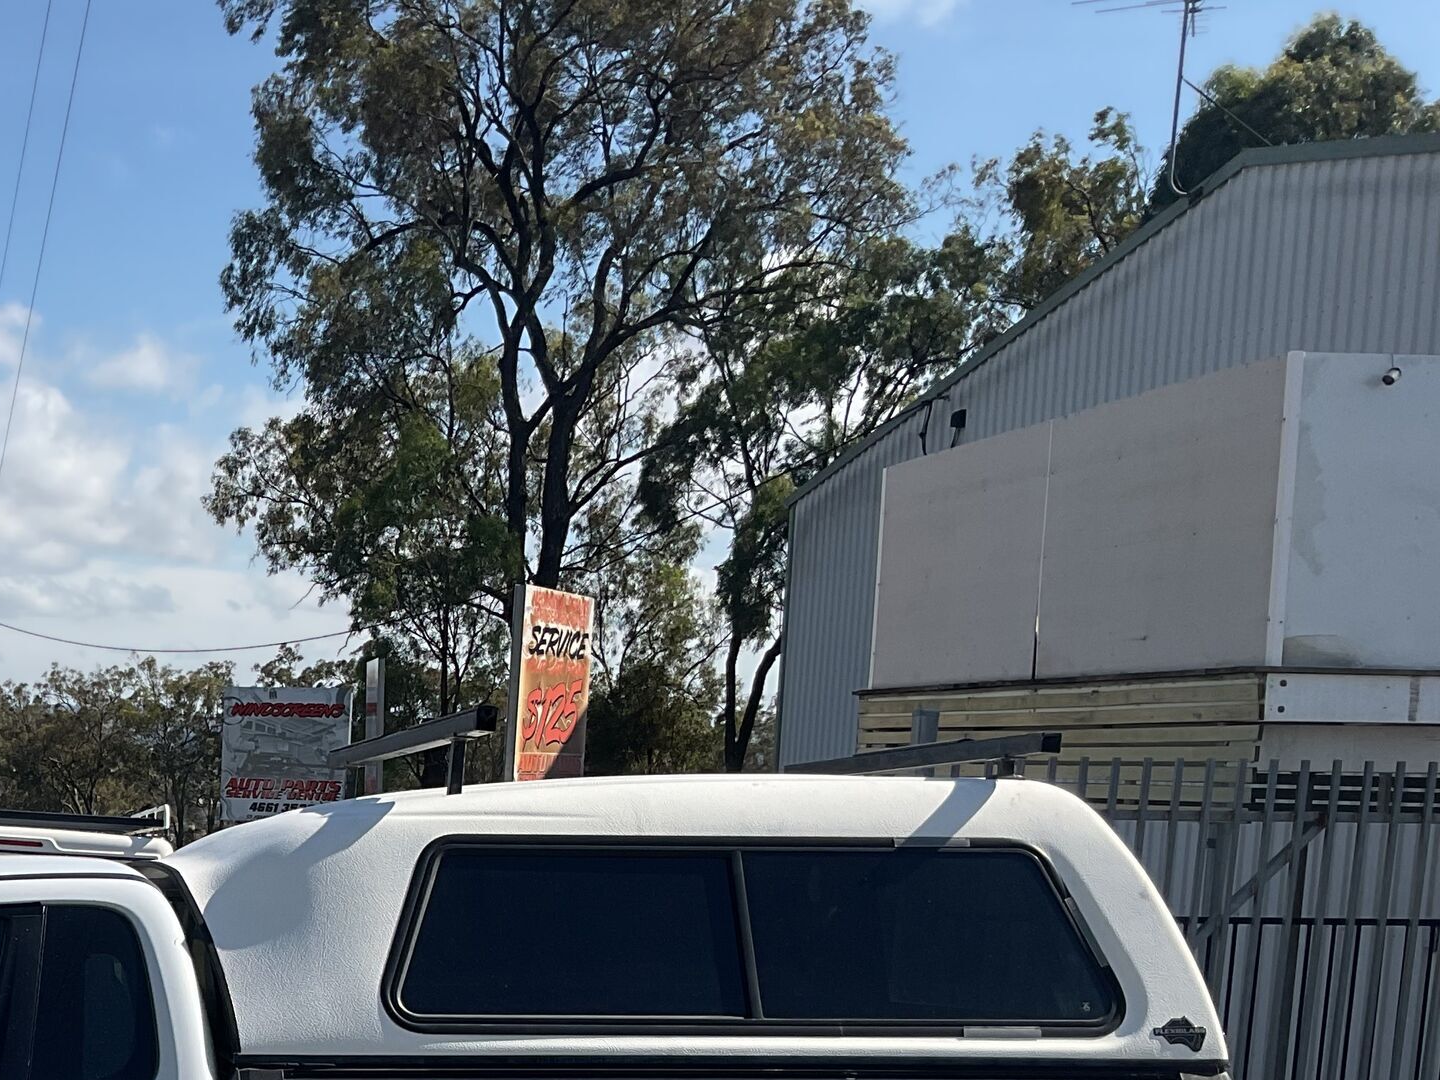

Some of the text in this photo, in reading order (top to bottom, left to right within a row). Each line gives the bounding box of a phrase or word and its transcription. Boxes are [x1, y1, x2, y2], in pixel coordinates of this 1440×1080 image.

[528, 624, 590, 660] SERVICE
[230, 702, 346, 719] WINDSCREENS
[522, 678, 584, 752] $125
[225, 777, 343, 795] AUTO PARTS
[225, 788, 342, 803] SERVICE CENTRE
[249, 802, 279, 813] 4661
